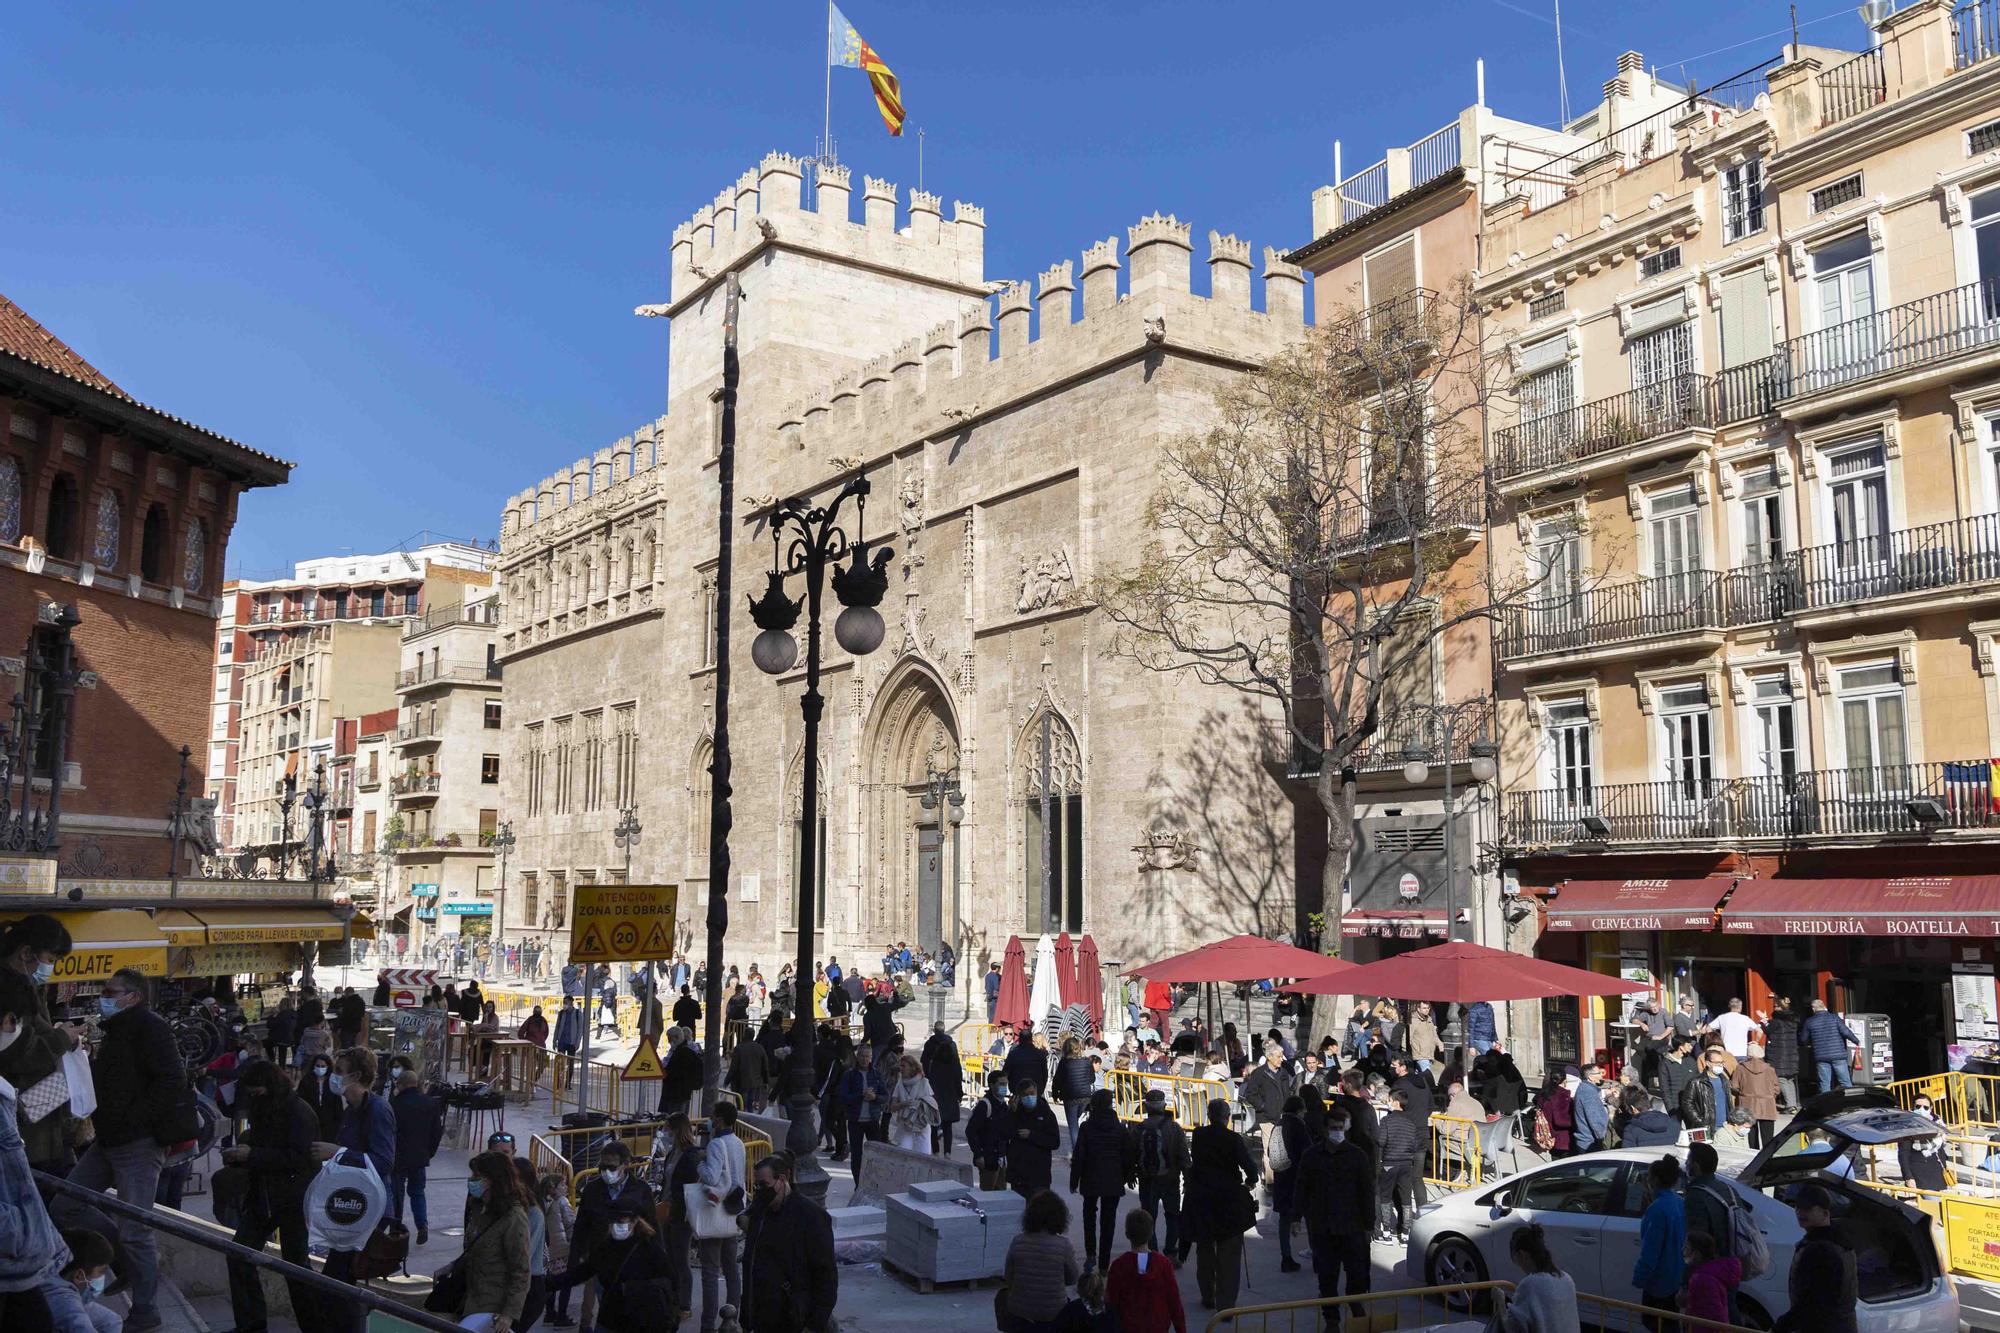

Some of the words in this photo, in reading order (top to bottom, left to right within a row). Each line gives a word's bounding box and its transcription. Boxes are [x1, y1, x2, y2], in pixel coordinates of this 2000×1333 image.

[1621, 879, 1671, 888] AMSTEL
[597, 891, 657, 902] ATENCIÓN
[578, 906, 611, 916] ZONA
[615, 905, 629, 915] DE
[632, 904, 671, 915] OBRAS
[1551, 919, 1572, 927] AMSTEL
[1591, 915, 1662, 930] CERVECERÍA
[1685, 917, 1710, 925] AMSTEL
[1727, 921, 1754, 929] AMSTEL
[1784, 917, 1865, 934] FREIDURÍA
[1886, 920, 1969, 934] BOATELLA
[213, 931, 246, 942] COMIDAS
[246, 930, 263, 941] PARA
[265, 930, 289, 940] LLEVAR
[290, 930, 297, 939] EL
[616, 932, 634, 944] 20
[52, 954, 114, 976] COLATE
[1985, 1212, 2000, 1220] ATE
[1967, 1235, 1980, 1243] DEL
[1968, 1228, 2000, 1239] CORTADA
[1972, 1252, 1999, 1263] ACCESO
[1980, 1261, 2000, 1271] VICEN
